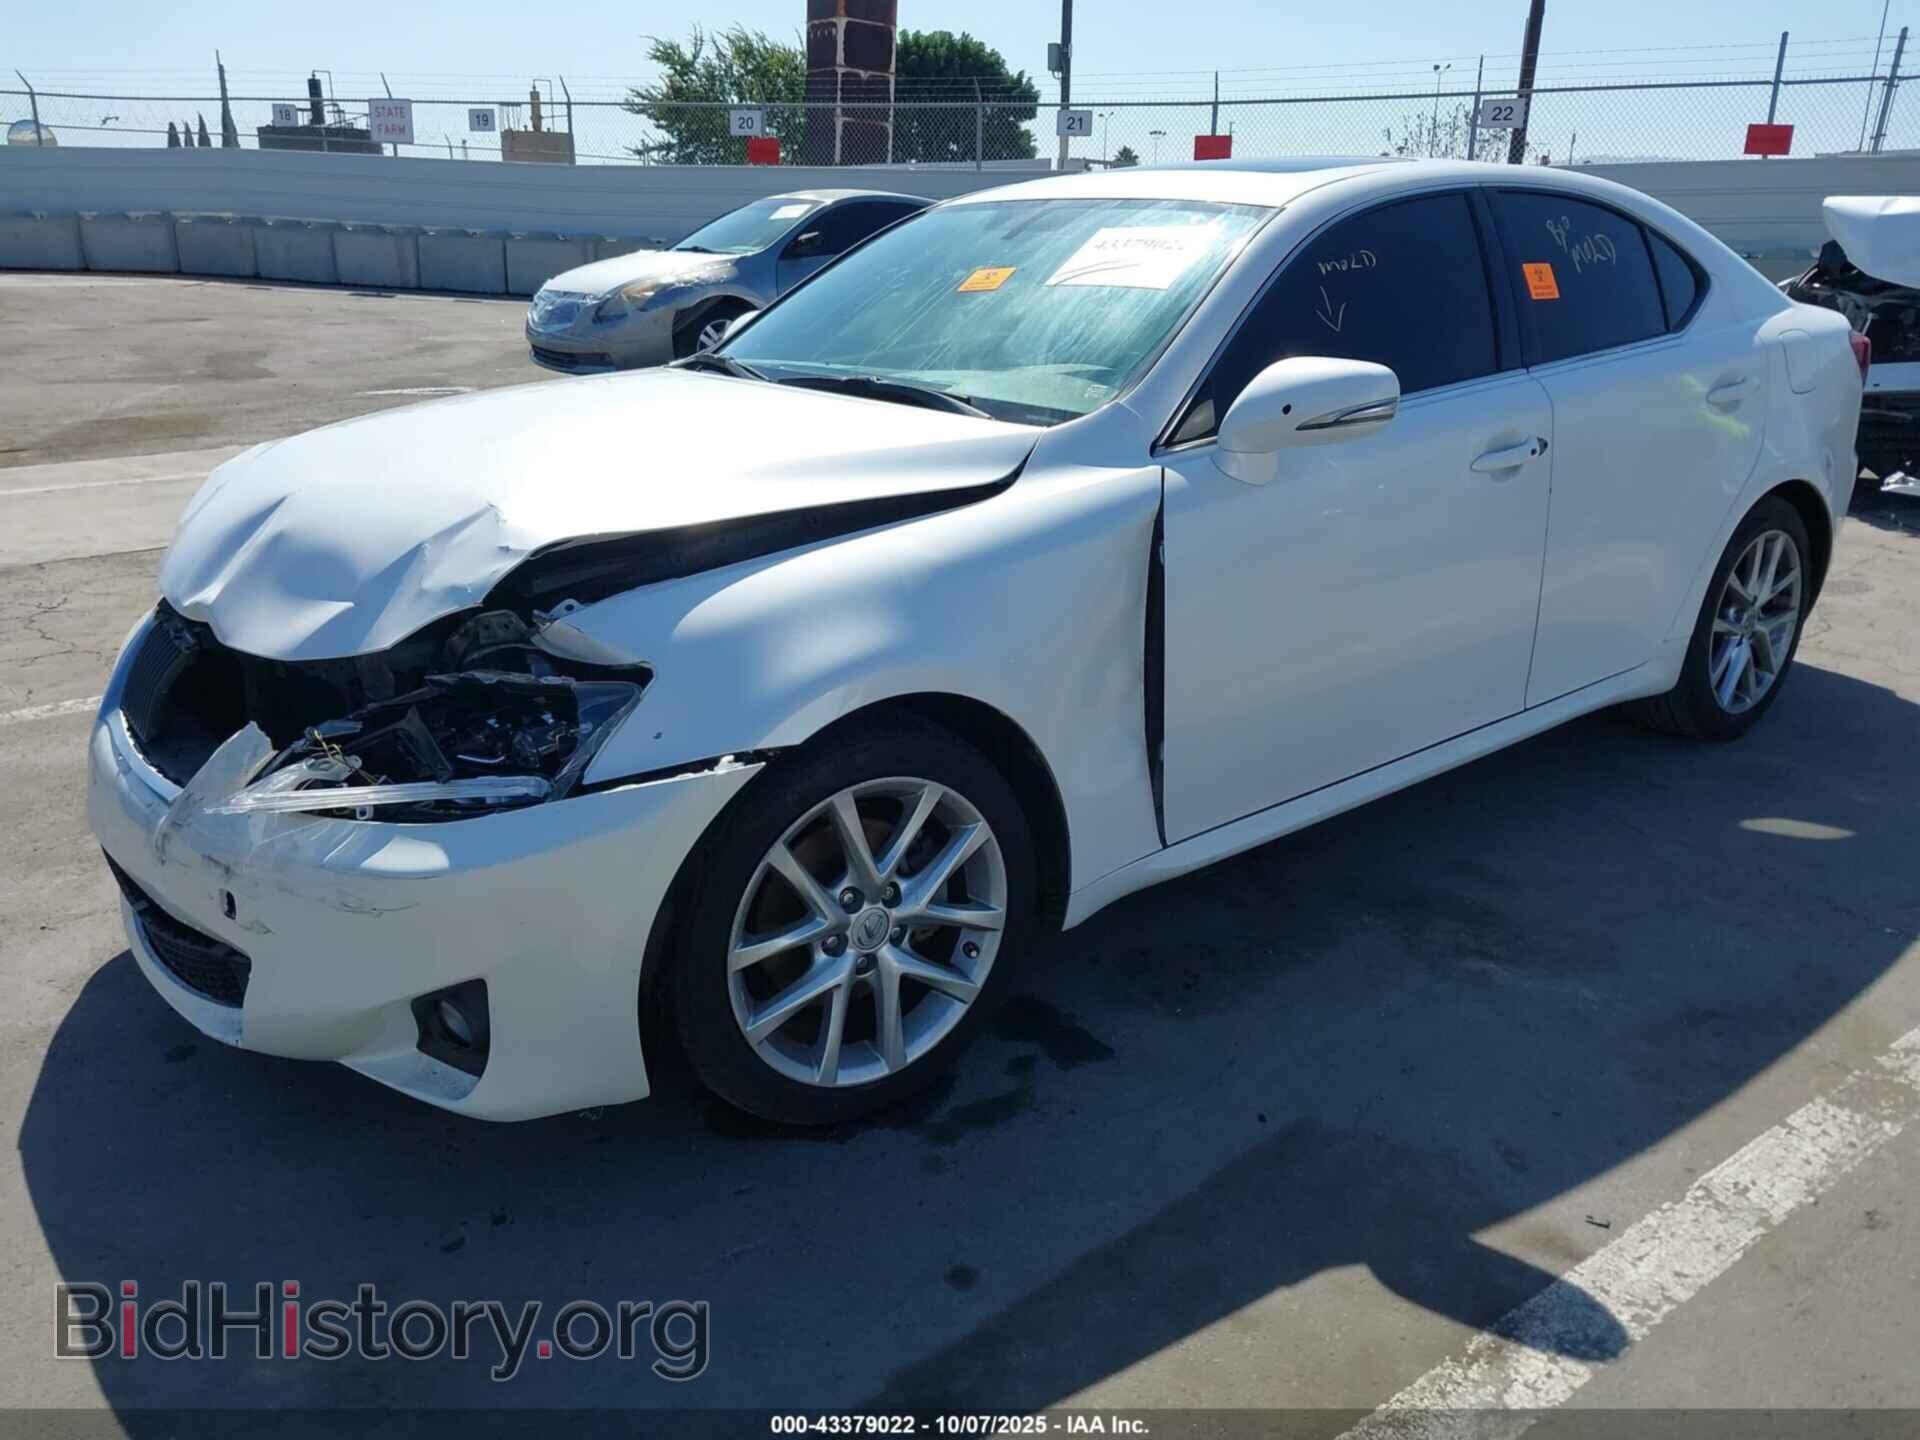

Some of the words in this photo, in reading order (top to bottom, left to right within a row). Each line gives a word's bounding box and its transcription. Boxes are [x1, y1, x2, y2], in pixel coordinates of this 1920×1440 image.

[279, 109, 291, 121] 18
[374, 105, 406, 119] STATE
[474, 112, 490, 126] 19
[1491, 105, 1514, 123] 22
[376, 122, 406, 137] FARM
[737, 116, 755, 131] 20
[1065, 116, 1084, 131] 21
